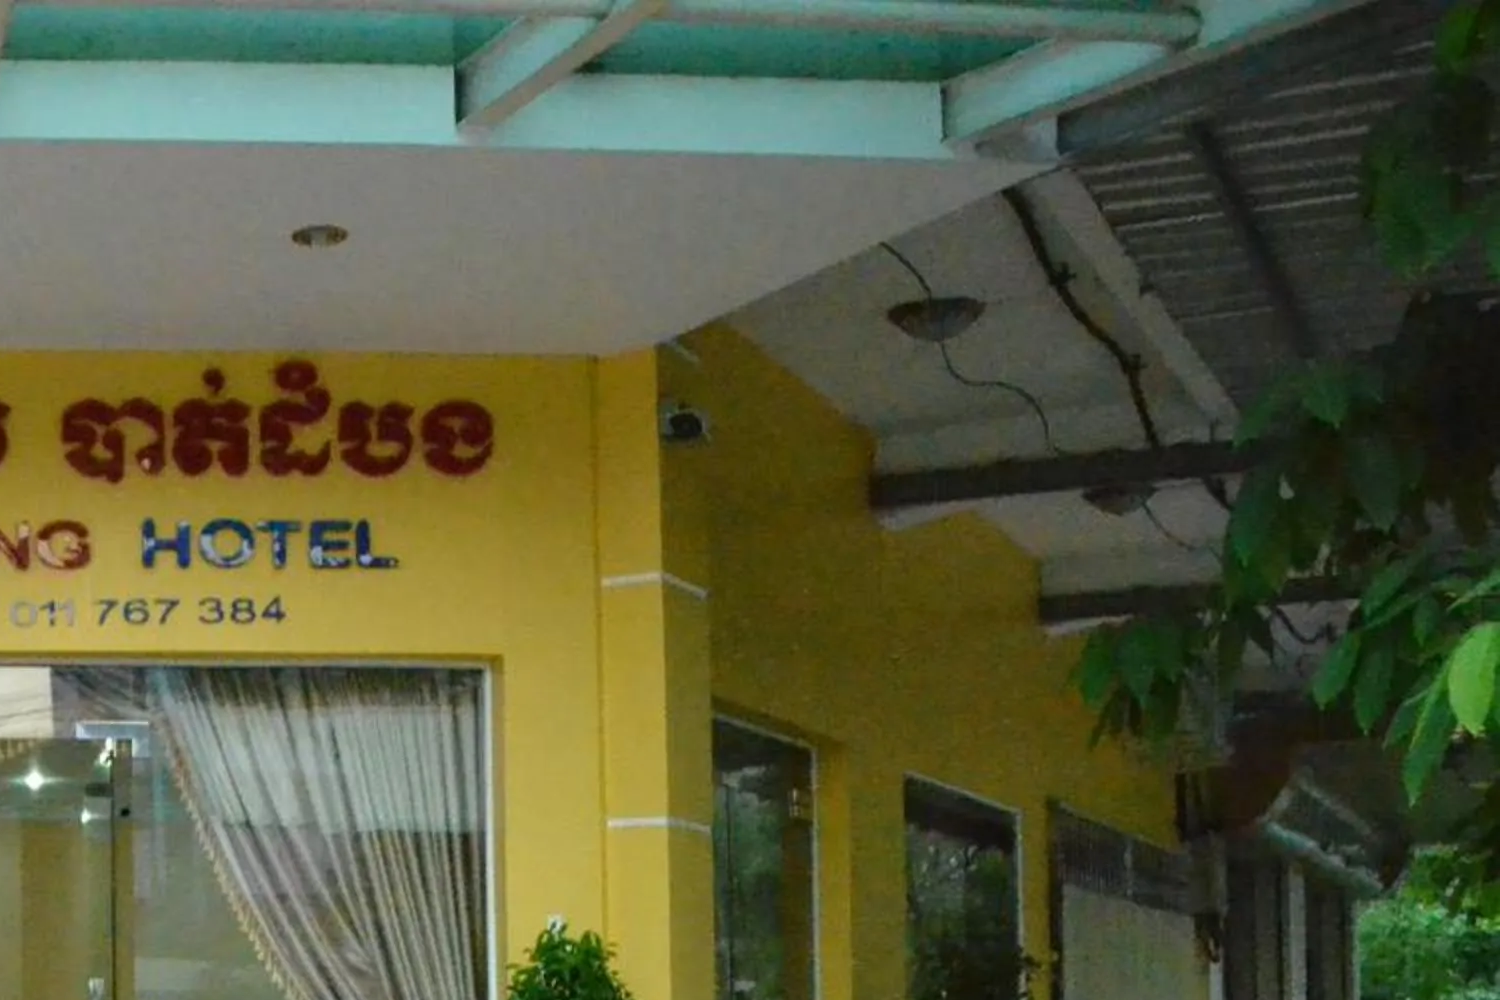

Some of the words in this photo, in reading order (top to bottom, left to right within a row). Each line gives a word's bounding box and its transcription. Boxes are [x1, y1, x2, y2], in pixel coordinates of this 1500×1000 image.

[141, 518, 399, 570] HOTEL
[96, 597, 181, 625] 767
[199, 595, 286, 625] 384
